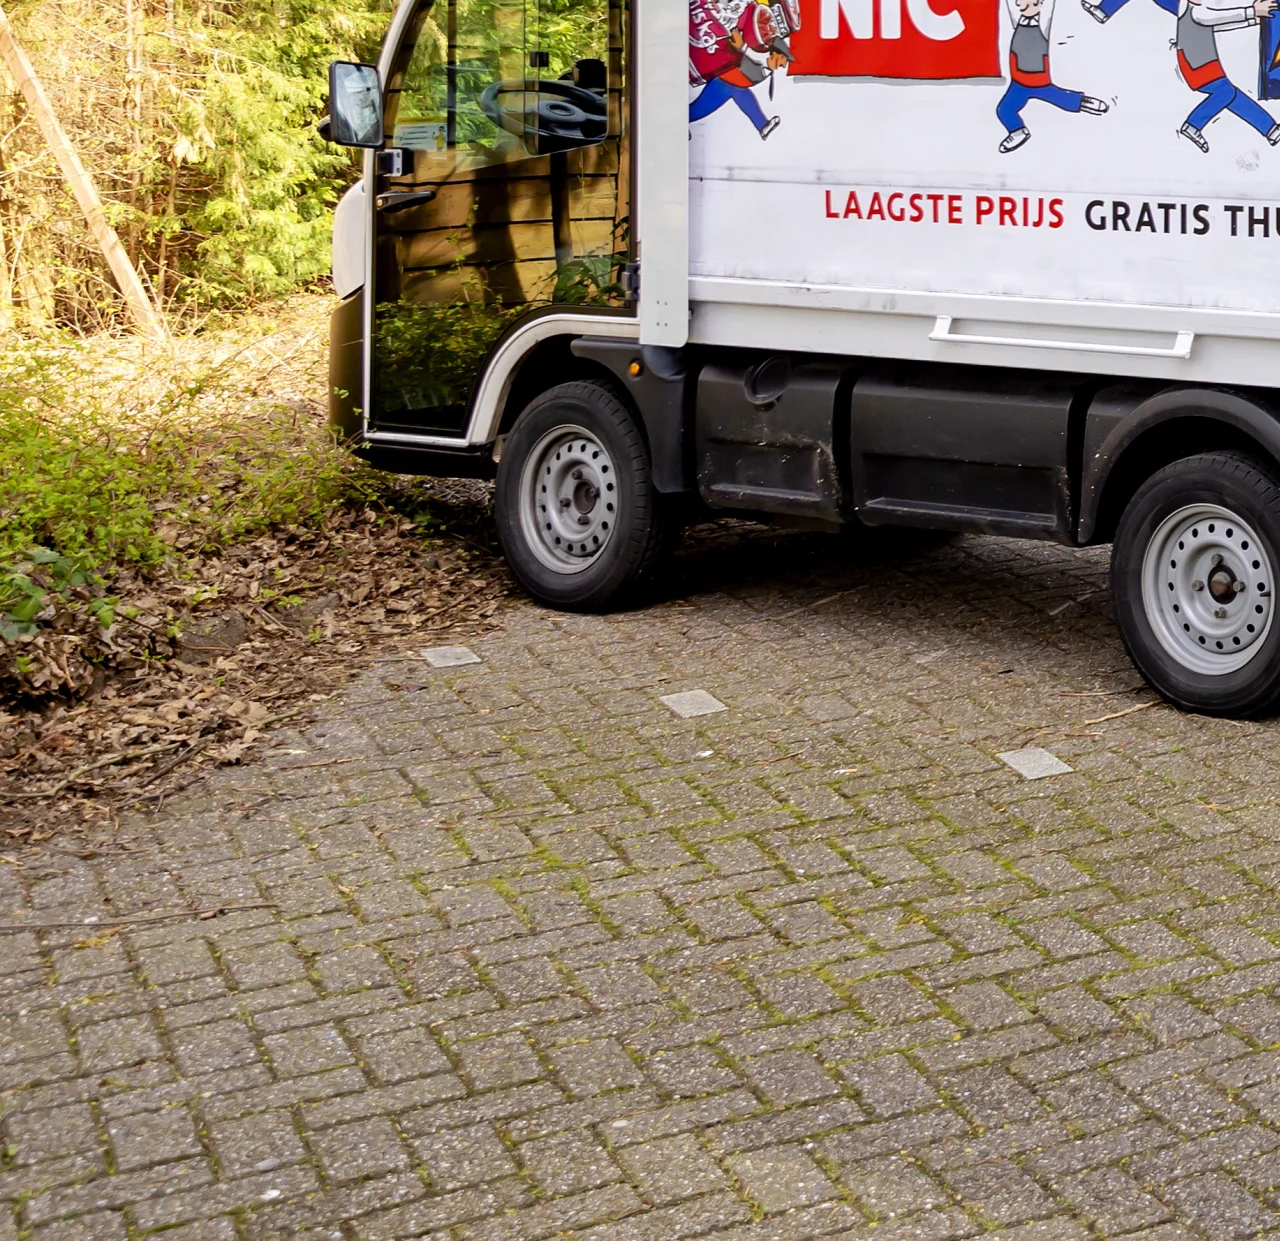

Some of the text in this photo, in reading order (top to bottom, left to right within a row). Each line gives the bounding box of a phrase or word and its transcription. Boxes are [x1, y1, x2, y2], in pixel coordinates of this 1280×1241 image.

[824, 190, 963, 225] LAAGSTE
[975, 196, 1064, 229] PRIJS
[1085, 200, 1210, 235] GRATIS
